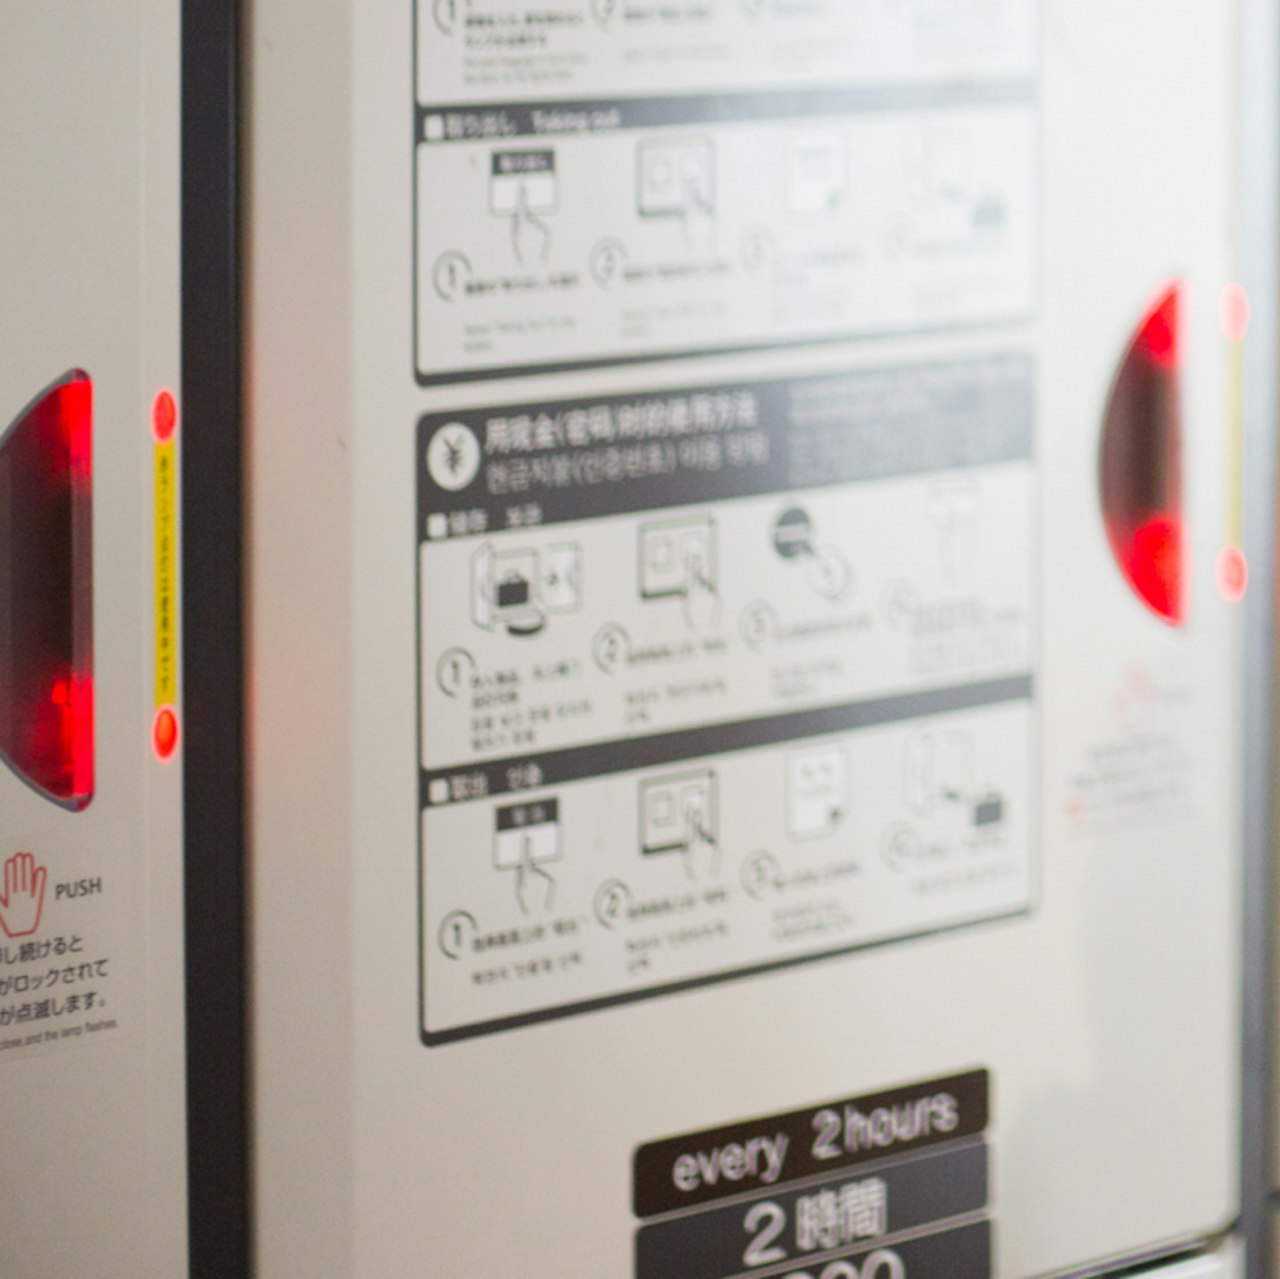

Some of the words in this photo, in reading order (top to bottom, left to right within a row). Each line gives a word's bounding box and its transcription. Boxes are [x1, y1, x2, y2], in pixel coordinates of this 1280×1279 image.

[55, 877, 102, 900] PUSH
[0, 934, 83, 965] し続けると
[672, 1131, 790, 1192] every
[743, 1176, 888, 1268] 2時間
